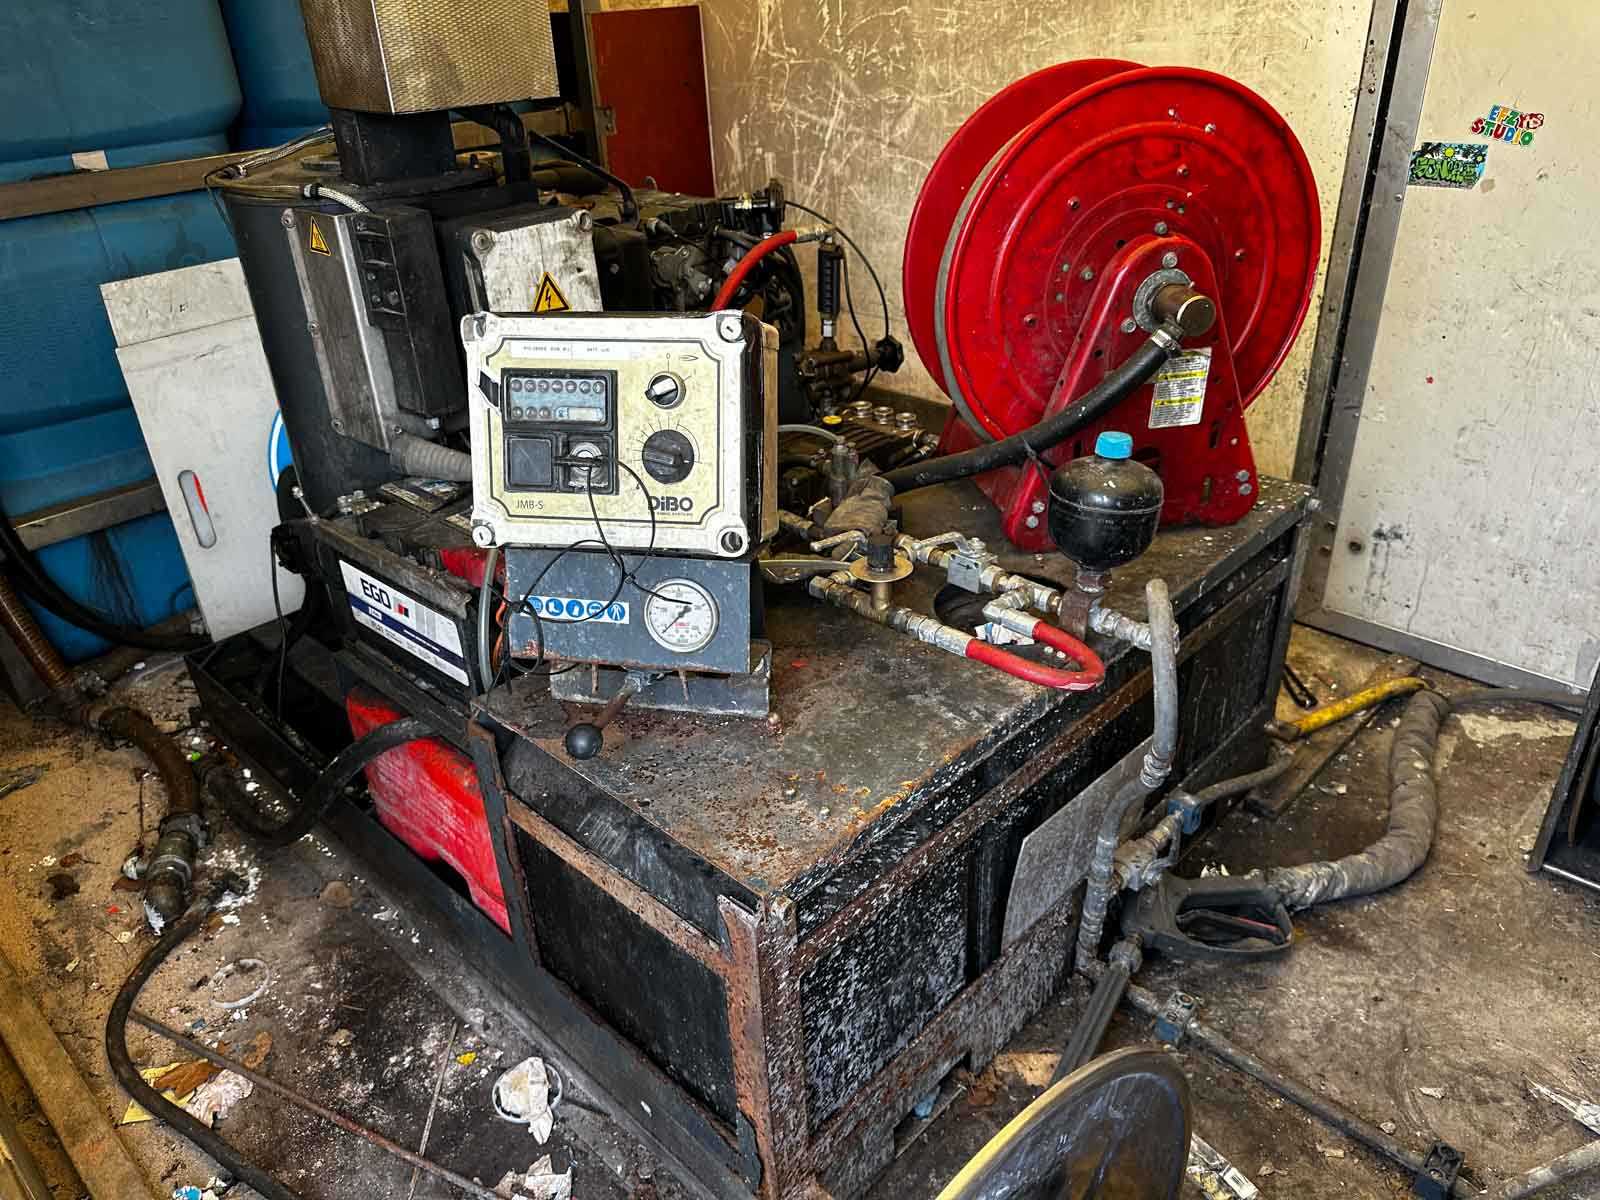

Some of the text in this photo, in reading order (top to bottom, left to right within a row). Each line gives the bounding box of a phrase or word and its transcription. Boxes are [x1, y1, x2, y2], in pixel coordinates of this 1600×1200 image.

[1471, 117, 1534, 145] STUDIO
[517, 499, 544, 510] JMB-S
[648, 495, 693, 511] DiBO
[360, 577, 392, 610] EGO
